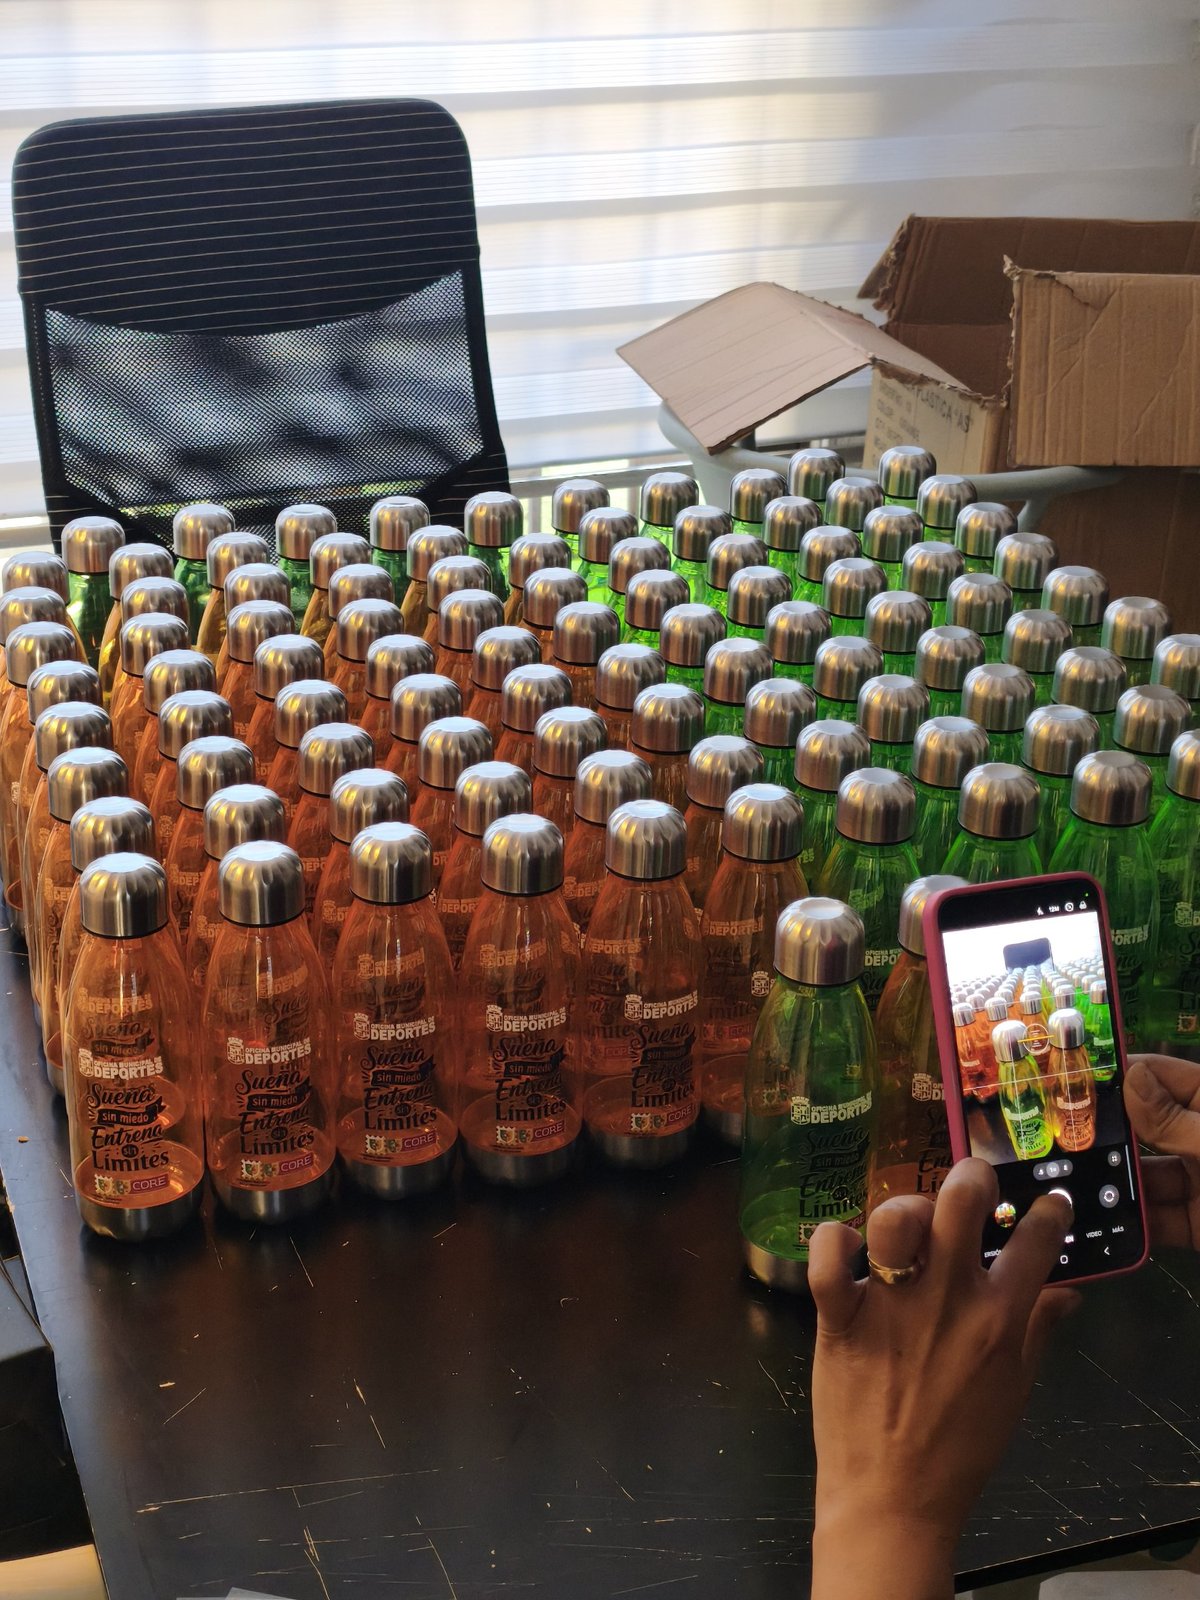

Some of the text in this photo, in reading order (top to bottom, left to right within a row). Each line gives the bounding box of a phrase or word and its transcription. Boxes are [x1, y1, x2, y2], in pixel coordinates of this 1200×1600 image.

[643, 998, 698, 1020] DEPORTES
[503, 1013, 567, 1032] DEPORTES
[370, 1022, 436, 1040] DEPORTES
[245, 1044, 311, 1064] DEPORTES
[94, 1063, 163, 1080] DEPORTES
[252, 1095, 298, 1106] sin miedo
[102, 1112, 149, 1123] sin miedo
[668, 1107, 691, 1121] CORE
[90, 1124, 163, 1149] Entrena
[534, 1123, 563, 1138] CORE
[404, 1133, 434, 1148] CORE
[281, 1156, 312, 1172] CORE
[132, 1176, 167, 1190] CORE
[1086, 1230, 1103, 1239] VIDEO
[1112, 1226, 1125, 1234] MÁS
